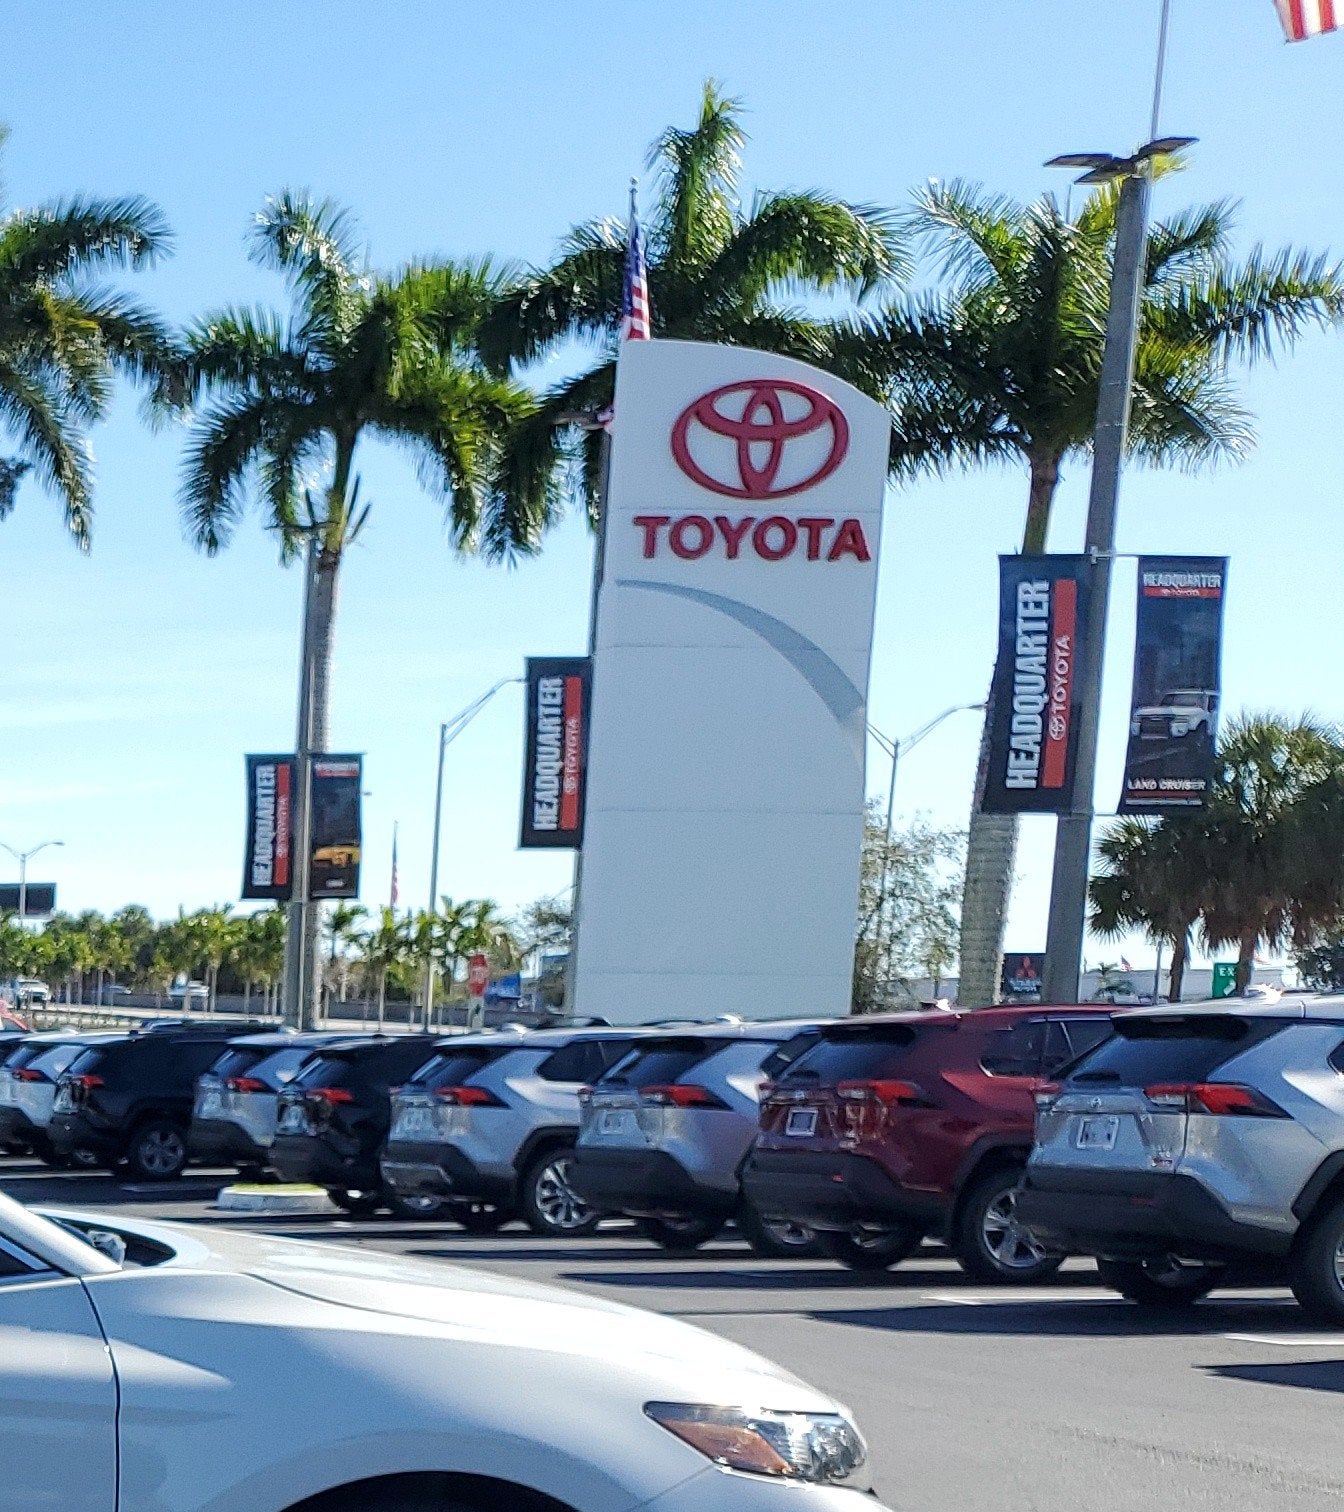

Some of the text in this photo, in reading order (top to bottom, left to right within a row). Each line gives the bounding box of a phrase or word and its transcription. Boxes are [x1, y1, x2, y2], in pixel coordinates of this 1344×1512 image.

[633, 515, 872, 562] TOYOTA
[1143, 573, 1221, 589] HEADQUARTER
[1006, 579, 1050, 789] HEADQUARTER
[1051, 634, 1071, 713] TOYOTA
[533, 677, 564, 831] HEADQUARTER
[564, 717, 580, 773] TOYOTA
[1128, 779, 1206, 791] LAND CRUISER
[252, 764, 276, 887] HEADQUARTER
